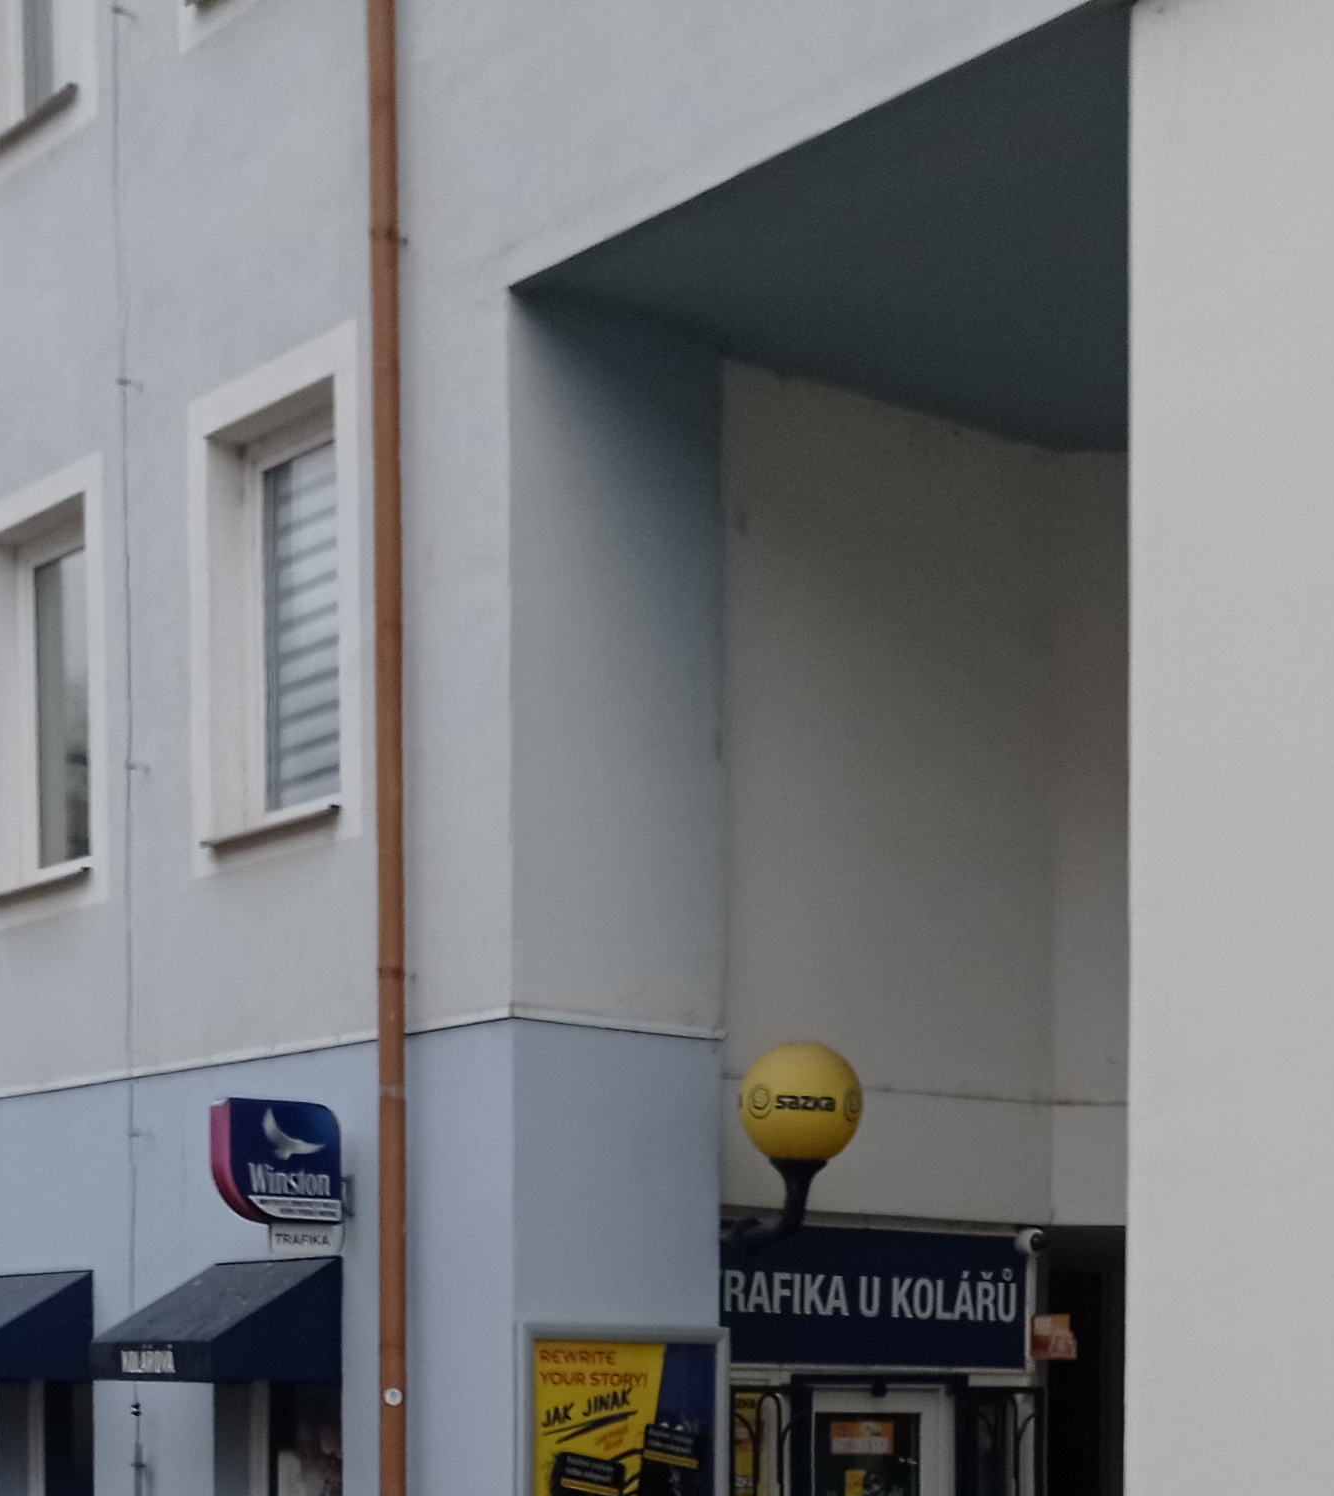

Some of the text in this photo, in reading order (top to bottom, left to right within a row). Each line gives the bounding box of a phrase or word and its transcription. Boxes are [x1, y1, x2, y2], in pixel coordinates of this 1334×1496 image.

[775, 1095, 835, 1112] sazka
[247, 1162, 331, 1196] Winston
[274, 1233, 330, 1246] TRAFIKA
[719, 1268, 1017, 1323] RAFIKA U KOLÁŘŮ
[539, 1350, 616, 1365] REWRITE
[539, 1371, 648, 1388] YOUR STORY!
[542, 1386, 633, 1427] JAK JINAK
